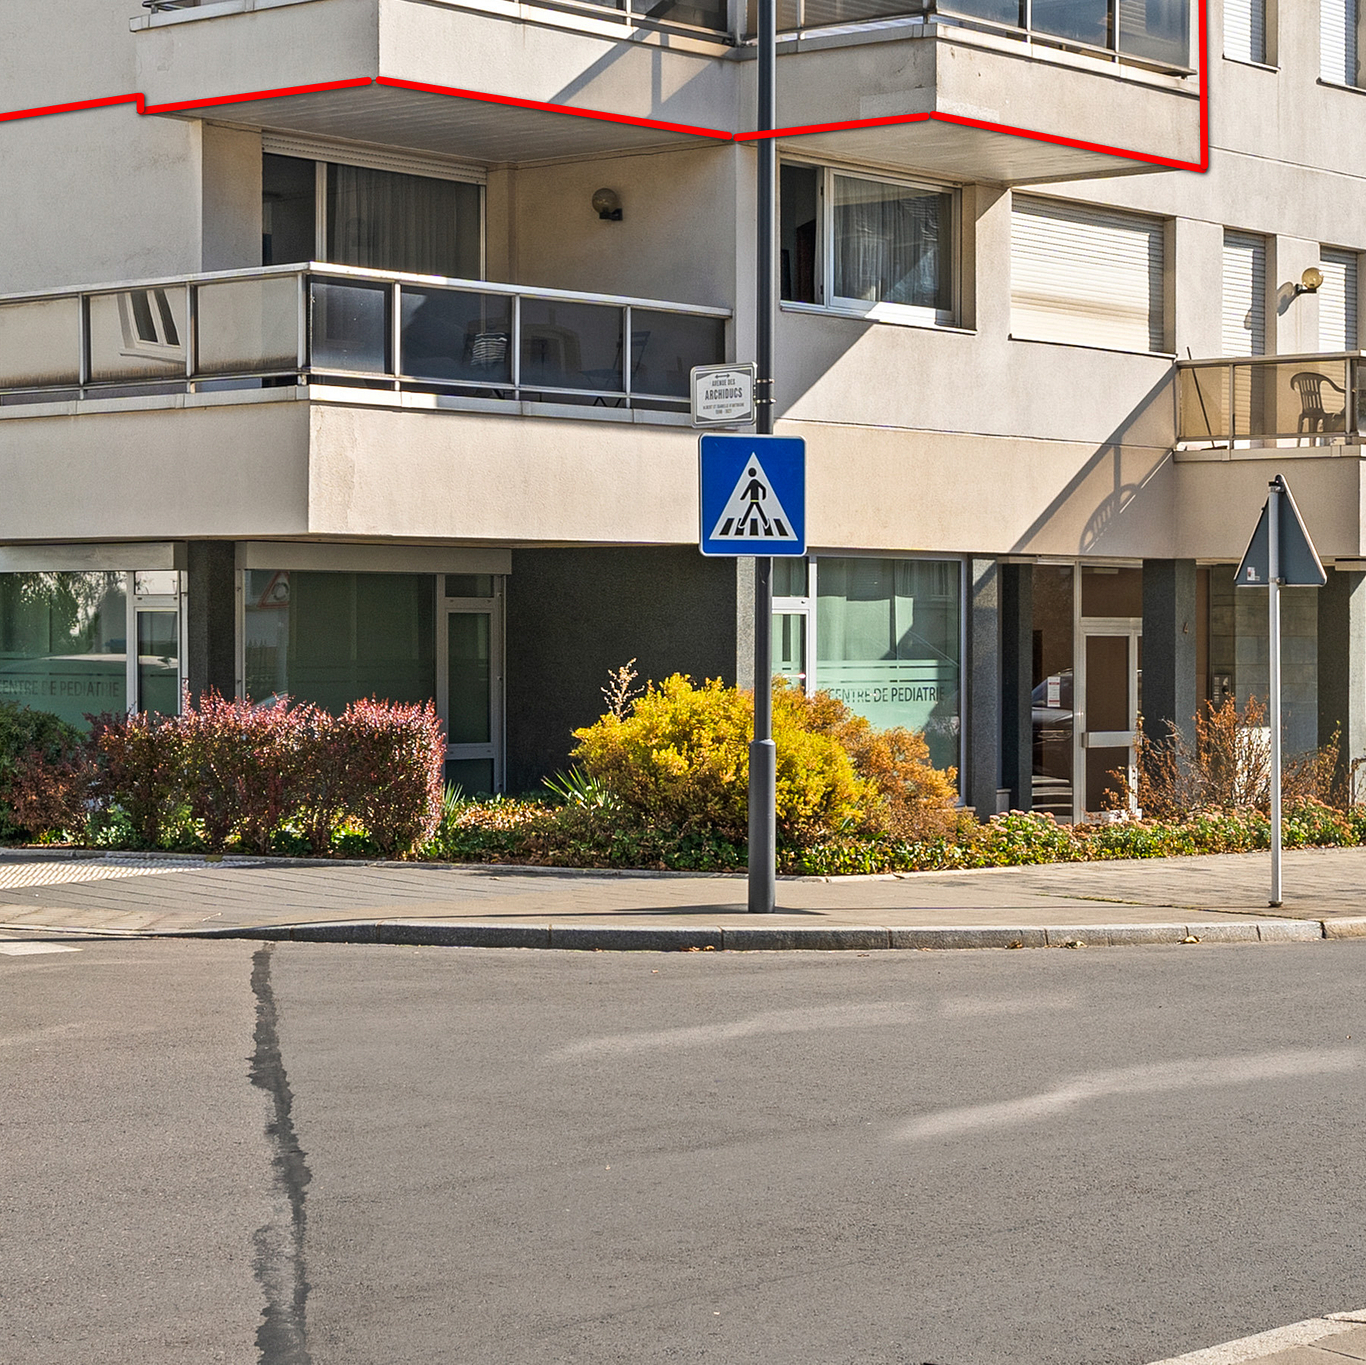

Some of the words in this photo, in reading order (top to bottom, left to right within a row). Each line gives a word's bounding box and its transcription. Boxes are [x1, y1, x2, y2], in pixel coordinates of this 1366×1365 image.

[727, 378, 736, 386] DES
[704, 387, 743, 401] ARCHIDUCS
[41, 680, 57, 696] DE
[60, 680, 120, 698] PEDIATRIE
[828, 688, 871, 703] CENTRE
[873, 687, 889, 703] DE
[891, 686, 946, 702] PEDIATRIE
